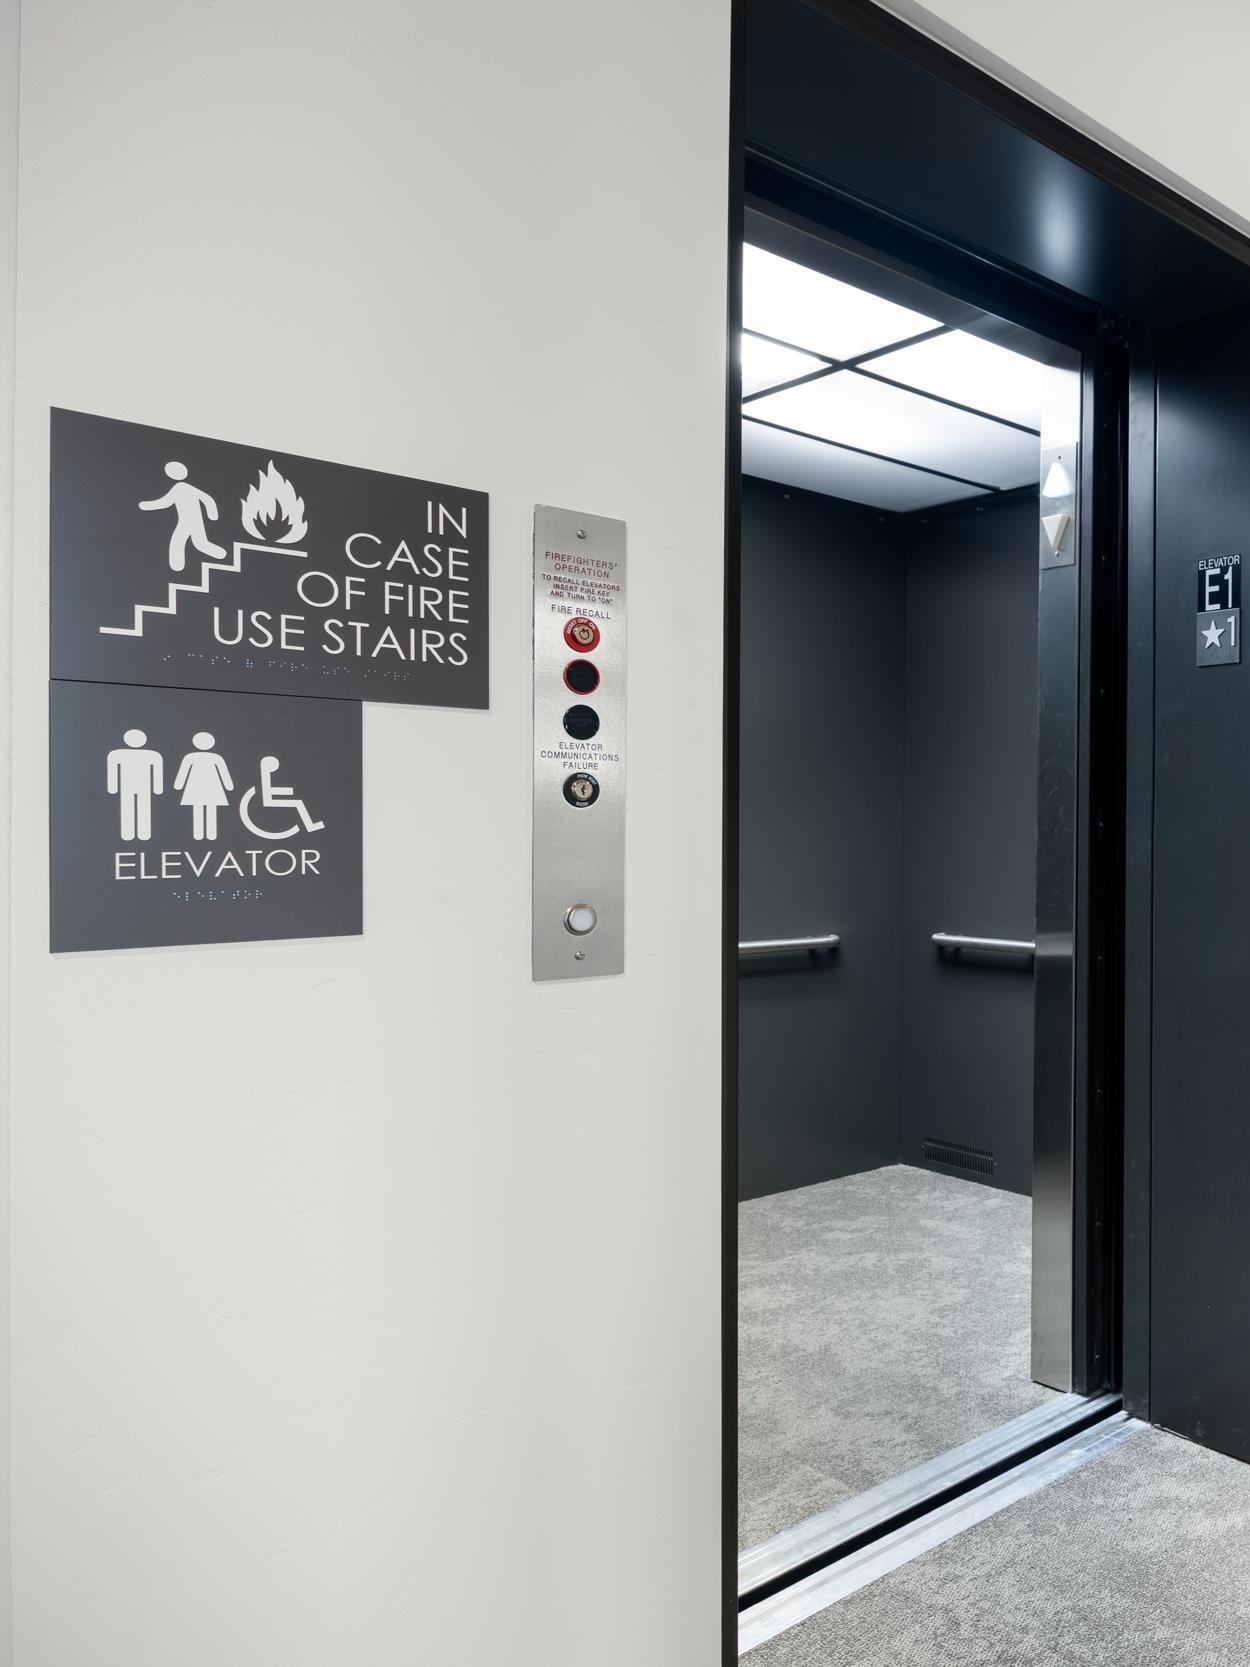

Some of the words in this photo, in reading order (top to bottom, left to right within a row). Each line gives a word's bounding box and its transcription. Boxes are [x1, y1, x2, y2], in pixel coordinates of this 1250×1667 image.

[427, 500, 467, 539] IN
[345, 532, 469, 582] CASE
[1198, 554, 1241, 571] ELEVATOR
[554, 562, 610, 578] OPERATION
[542, 573, 552, 581] TO
[553, 575, 580, 586] RECALL
[581, 580, 621, 592] ELEVATORS
[552, 583, 578, 592] INSERT
[1205, 565, 1233, 612] E1
[296, 571, 366, 610] OF
[384, 581, 469, 624] FIRE
[550, 590, 564, 598] AND
[567, 592, 585, 600] TURN
[551, 604, 573, 615] FIRE
[575, 607, 611, 620] RECALL
[213, 606, 305, 651] USE
[321, 618, 468, 666] STAIRS
[1226, 615, 1236, 647] 1
[559, 741, 603, 752] ELEVATOR
[540, 750, 620, 762] COMMUNICATIONS
[563, 761, 599, 770] FAILURE
[115, 849, 321, 880] ELEVATOR
